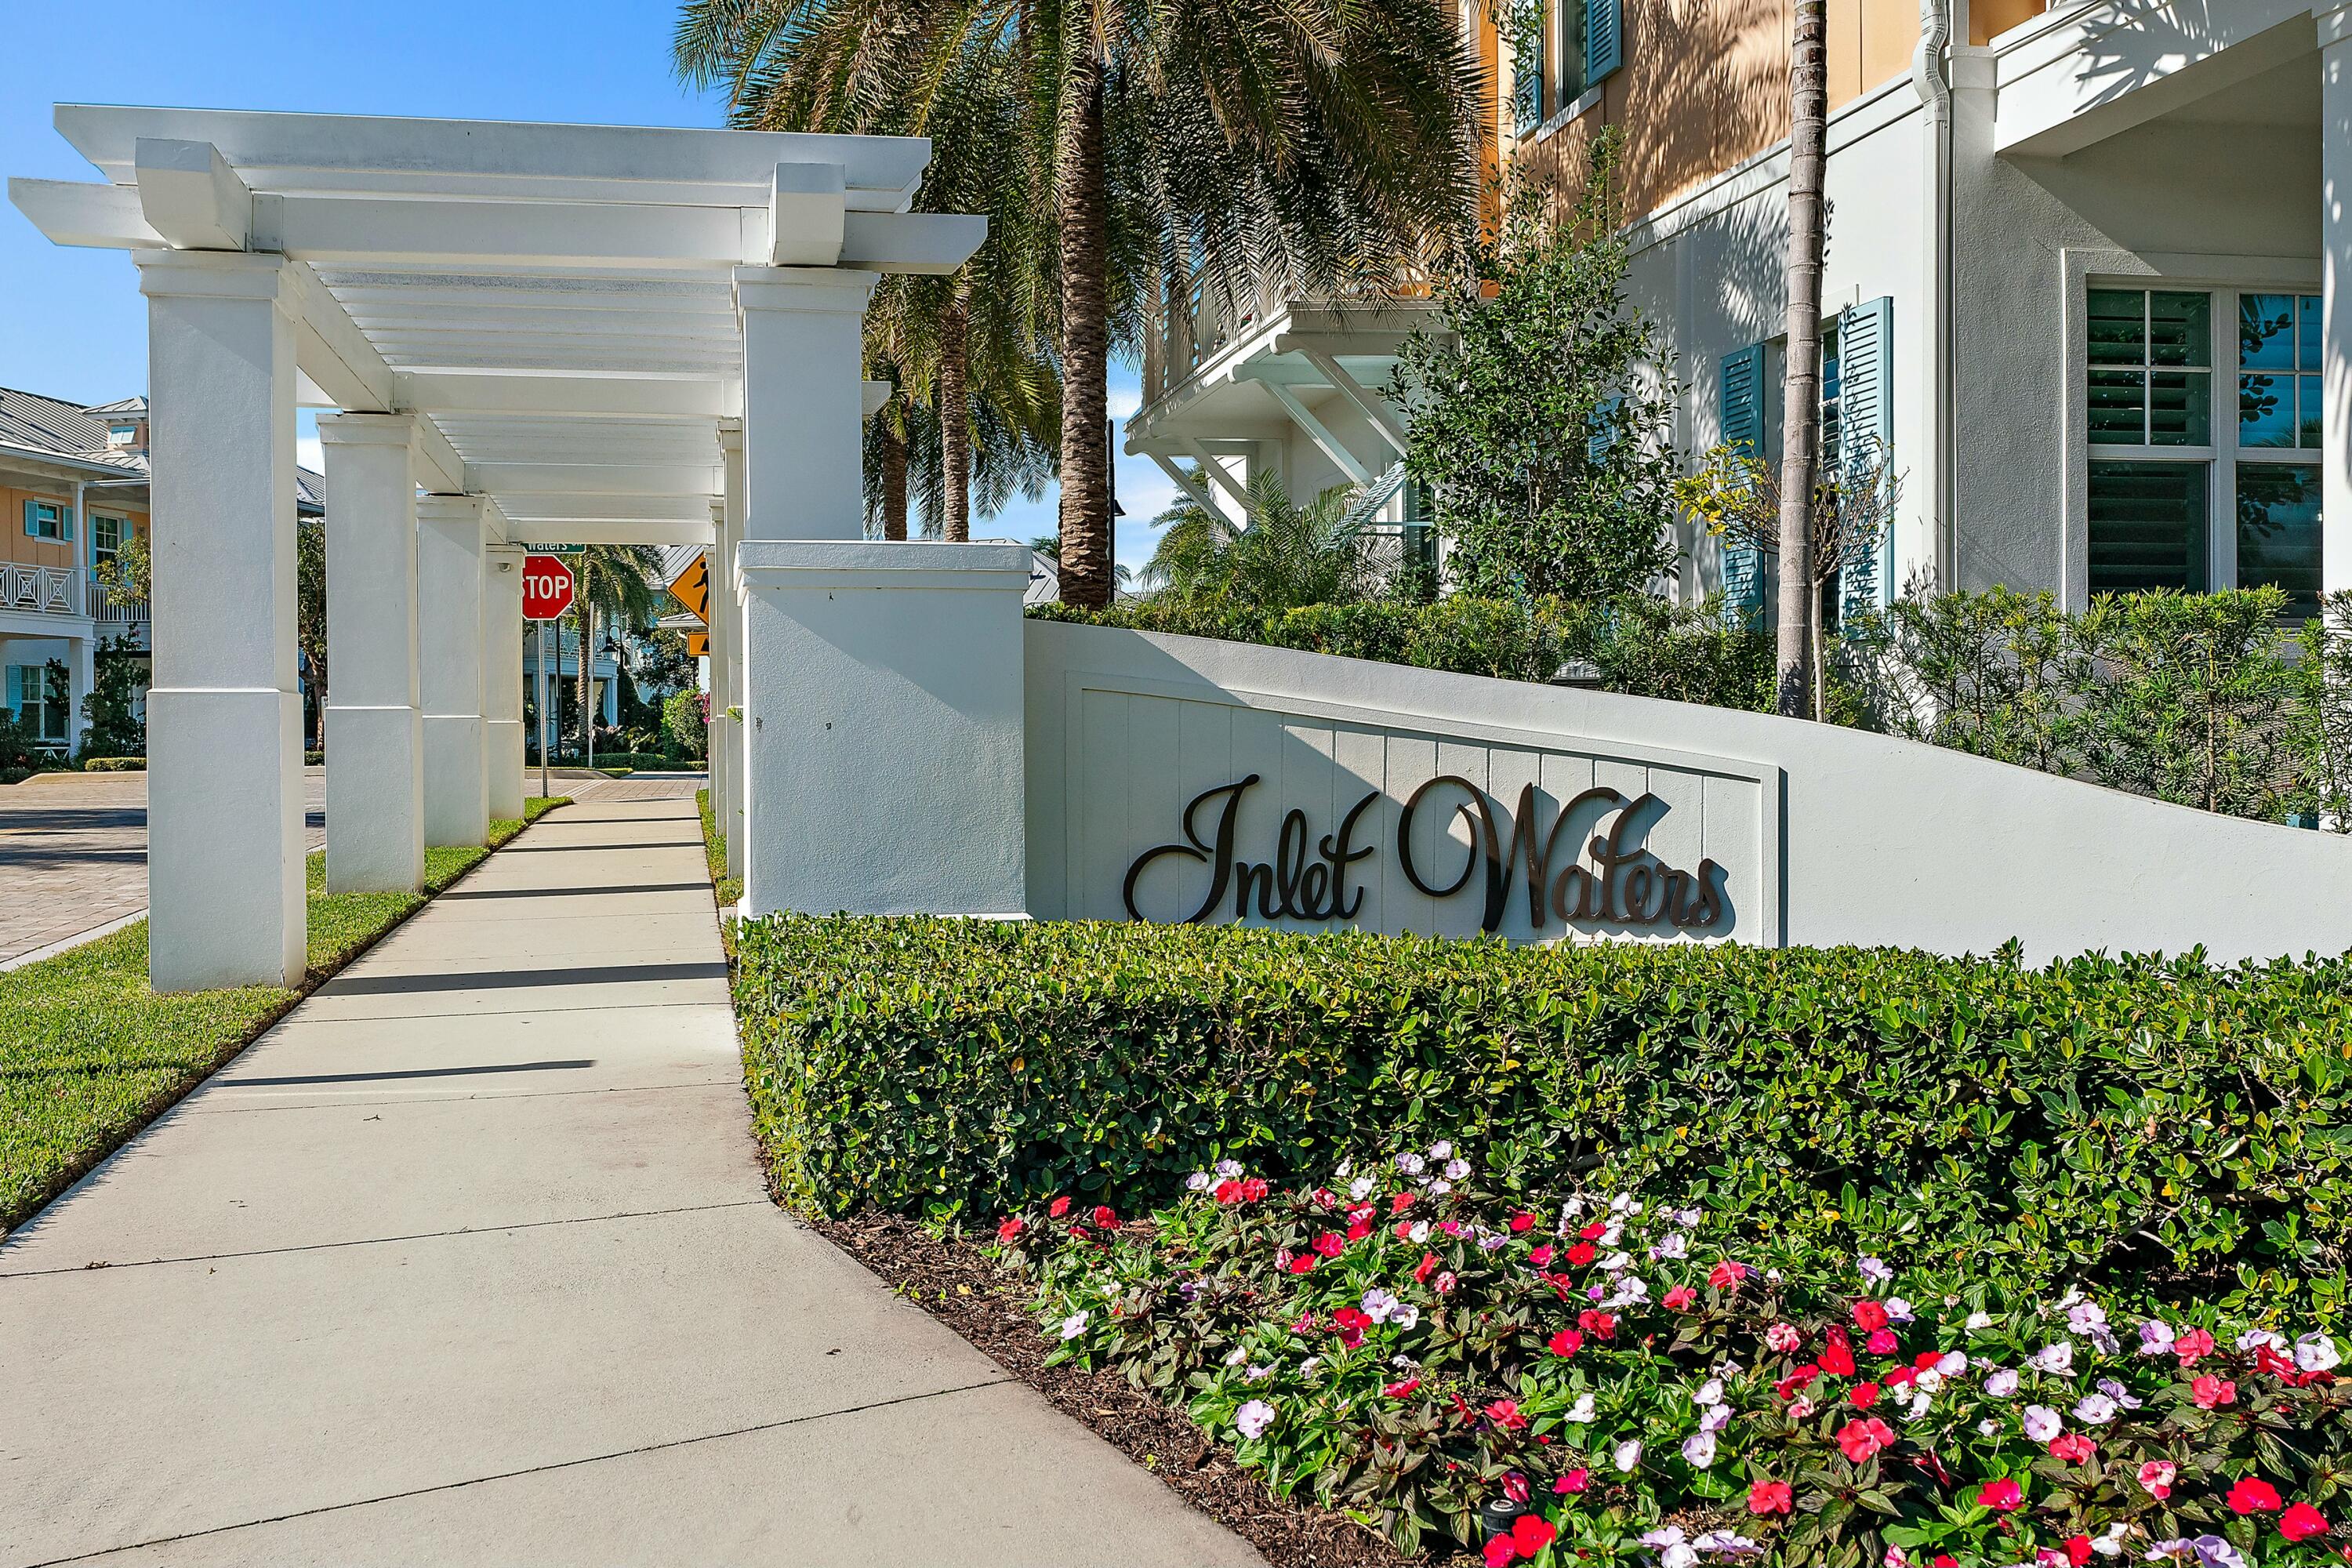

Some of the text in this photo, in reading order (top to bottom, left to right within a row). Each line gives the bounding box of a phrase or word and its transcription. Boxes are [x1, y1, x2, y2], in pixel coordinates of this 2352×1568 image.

[521, 575, 569, 599] TOP
[1123, 773, 1721, 932] Inlet Waters
